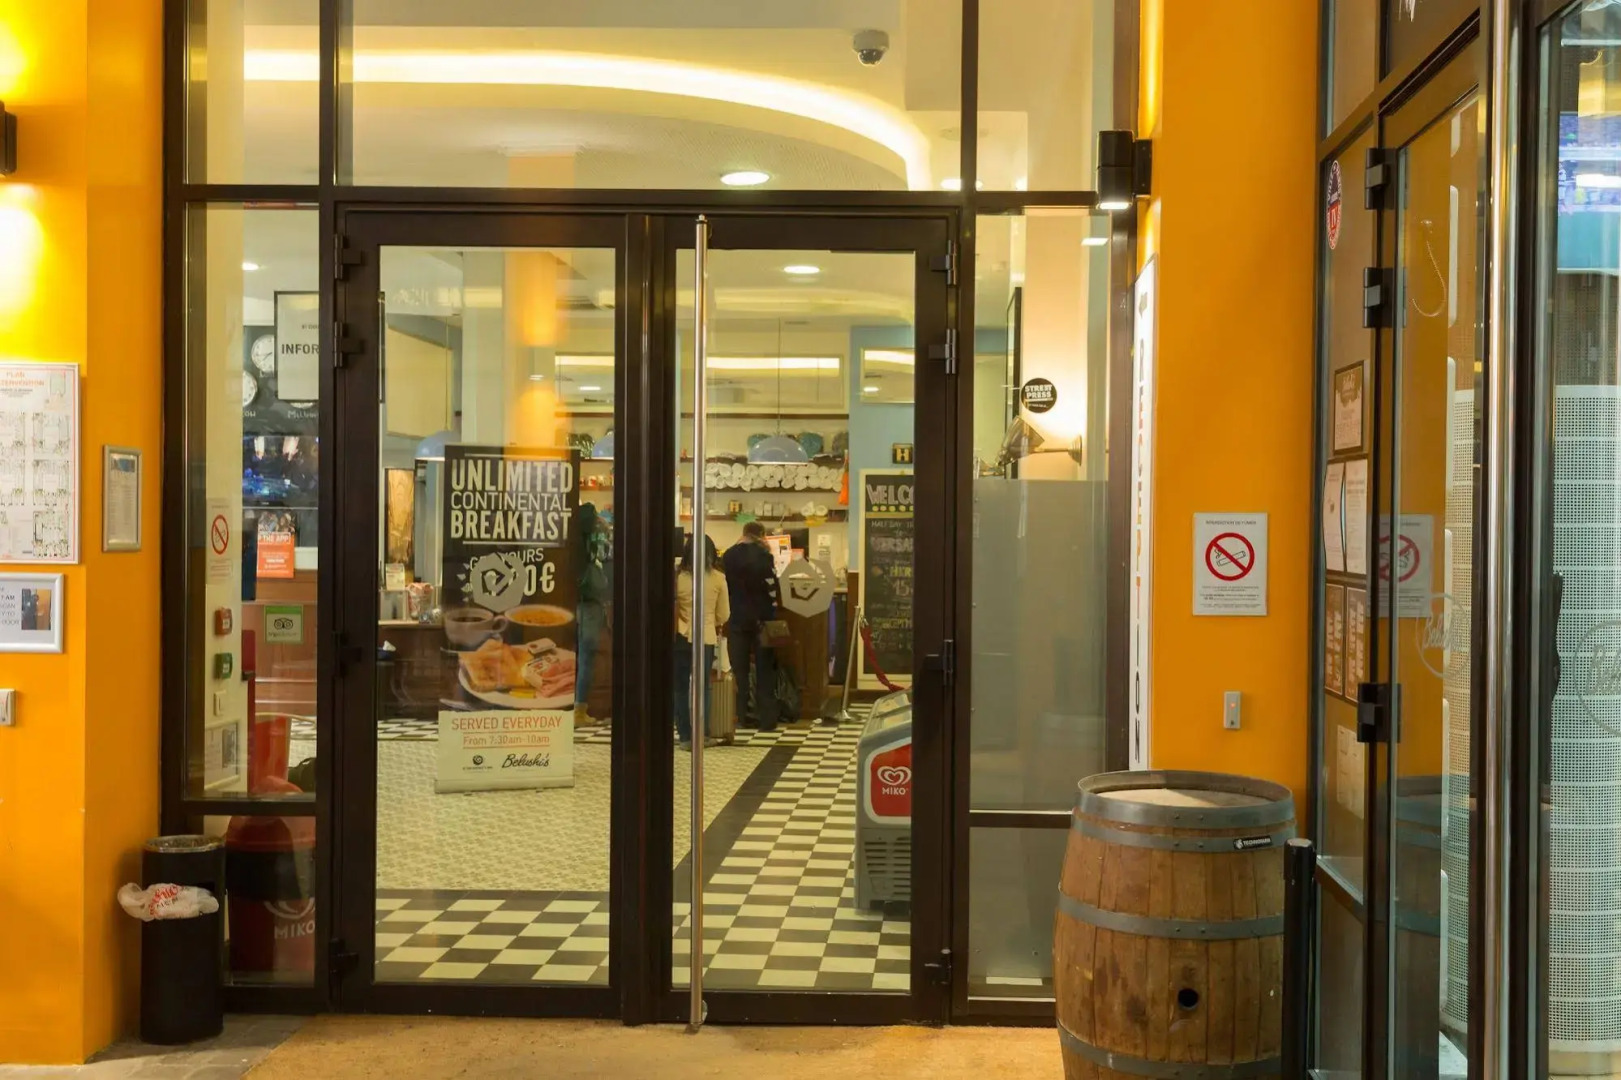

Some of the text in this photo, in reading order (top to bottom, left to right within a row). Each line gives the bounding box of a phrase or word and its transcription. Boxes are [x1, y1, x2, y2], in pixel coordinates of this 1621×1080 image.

[1026, 391, 1052, 400] PRESS
[452, 459, 573, 493] UNLIMITED
[450, 491, 572, 512] CONTINENTAL
[450, 510, 572, 540] BREAKFAST
[452, 715, 563, 731] SERVED EVERYDAY
[463, 735, 487, 746] From
[501, 753, 551, 769] Belushi's
[882, 787, 906, 796] MIKO
[274, 919, 316, 940] MIKO
